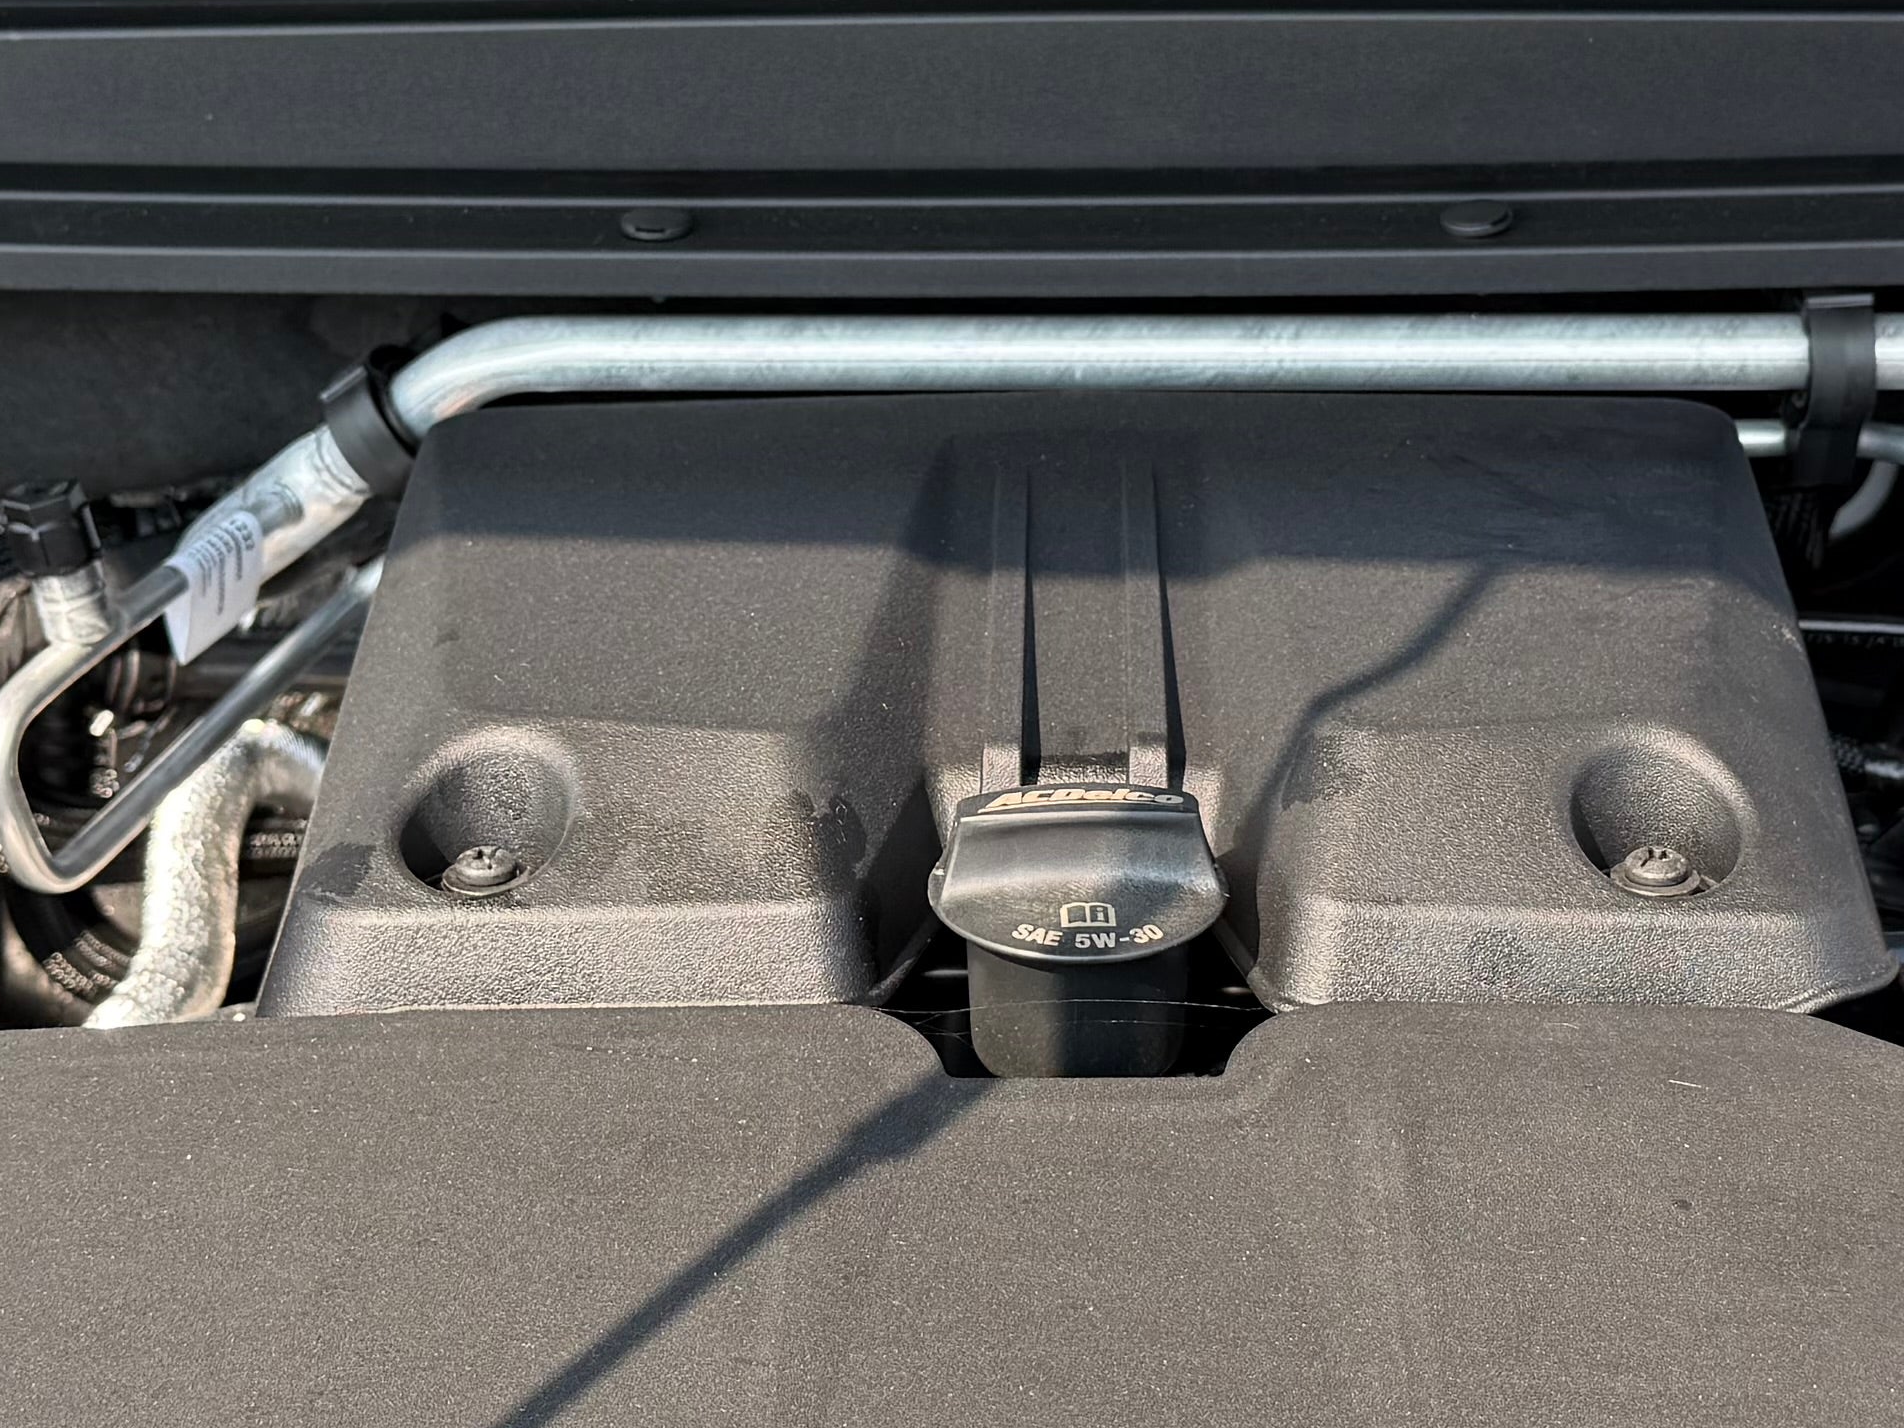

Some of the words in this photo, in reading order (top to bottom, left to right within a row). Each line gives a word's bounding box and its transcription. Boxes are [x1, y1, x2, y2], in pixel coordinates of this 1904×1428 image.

[981, 787, 1184, 811] ACDelco
[1012, 924, 1063, 946] SAE
[1075, 924, 1164, 948] 5W-30
